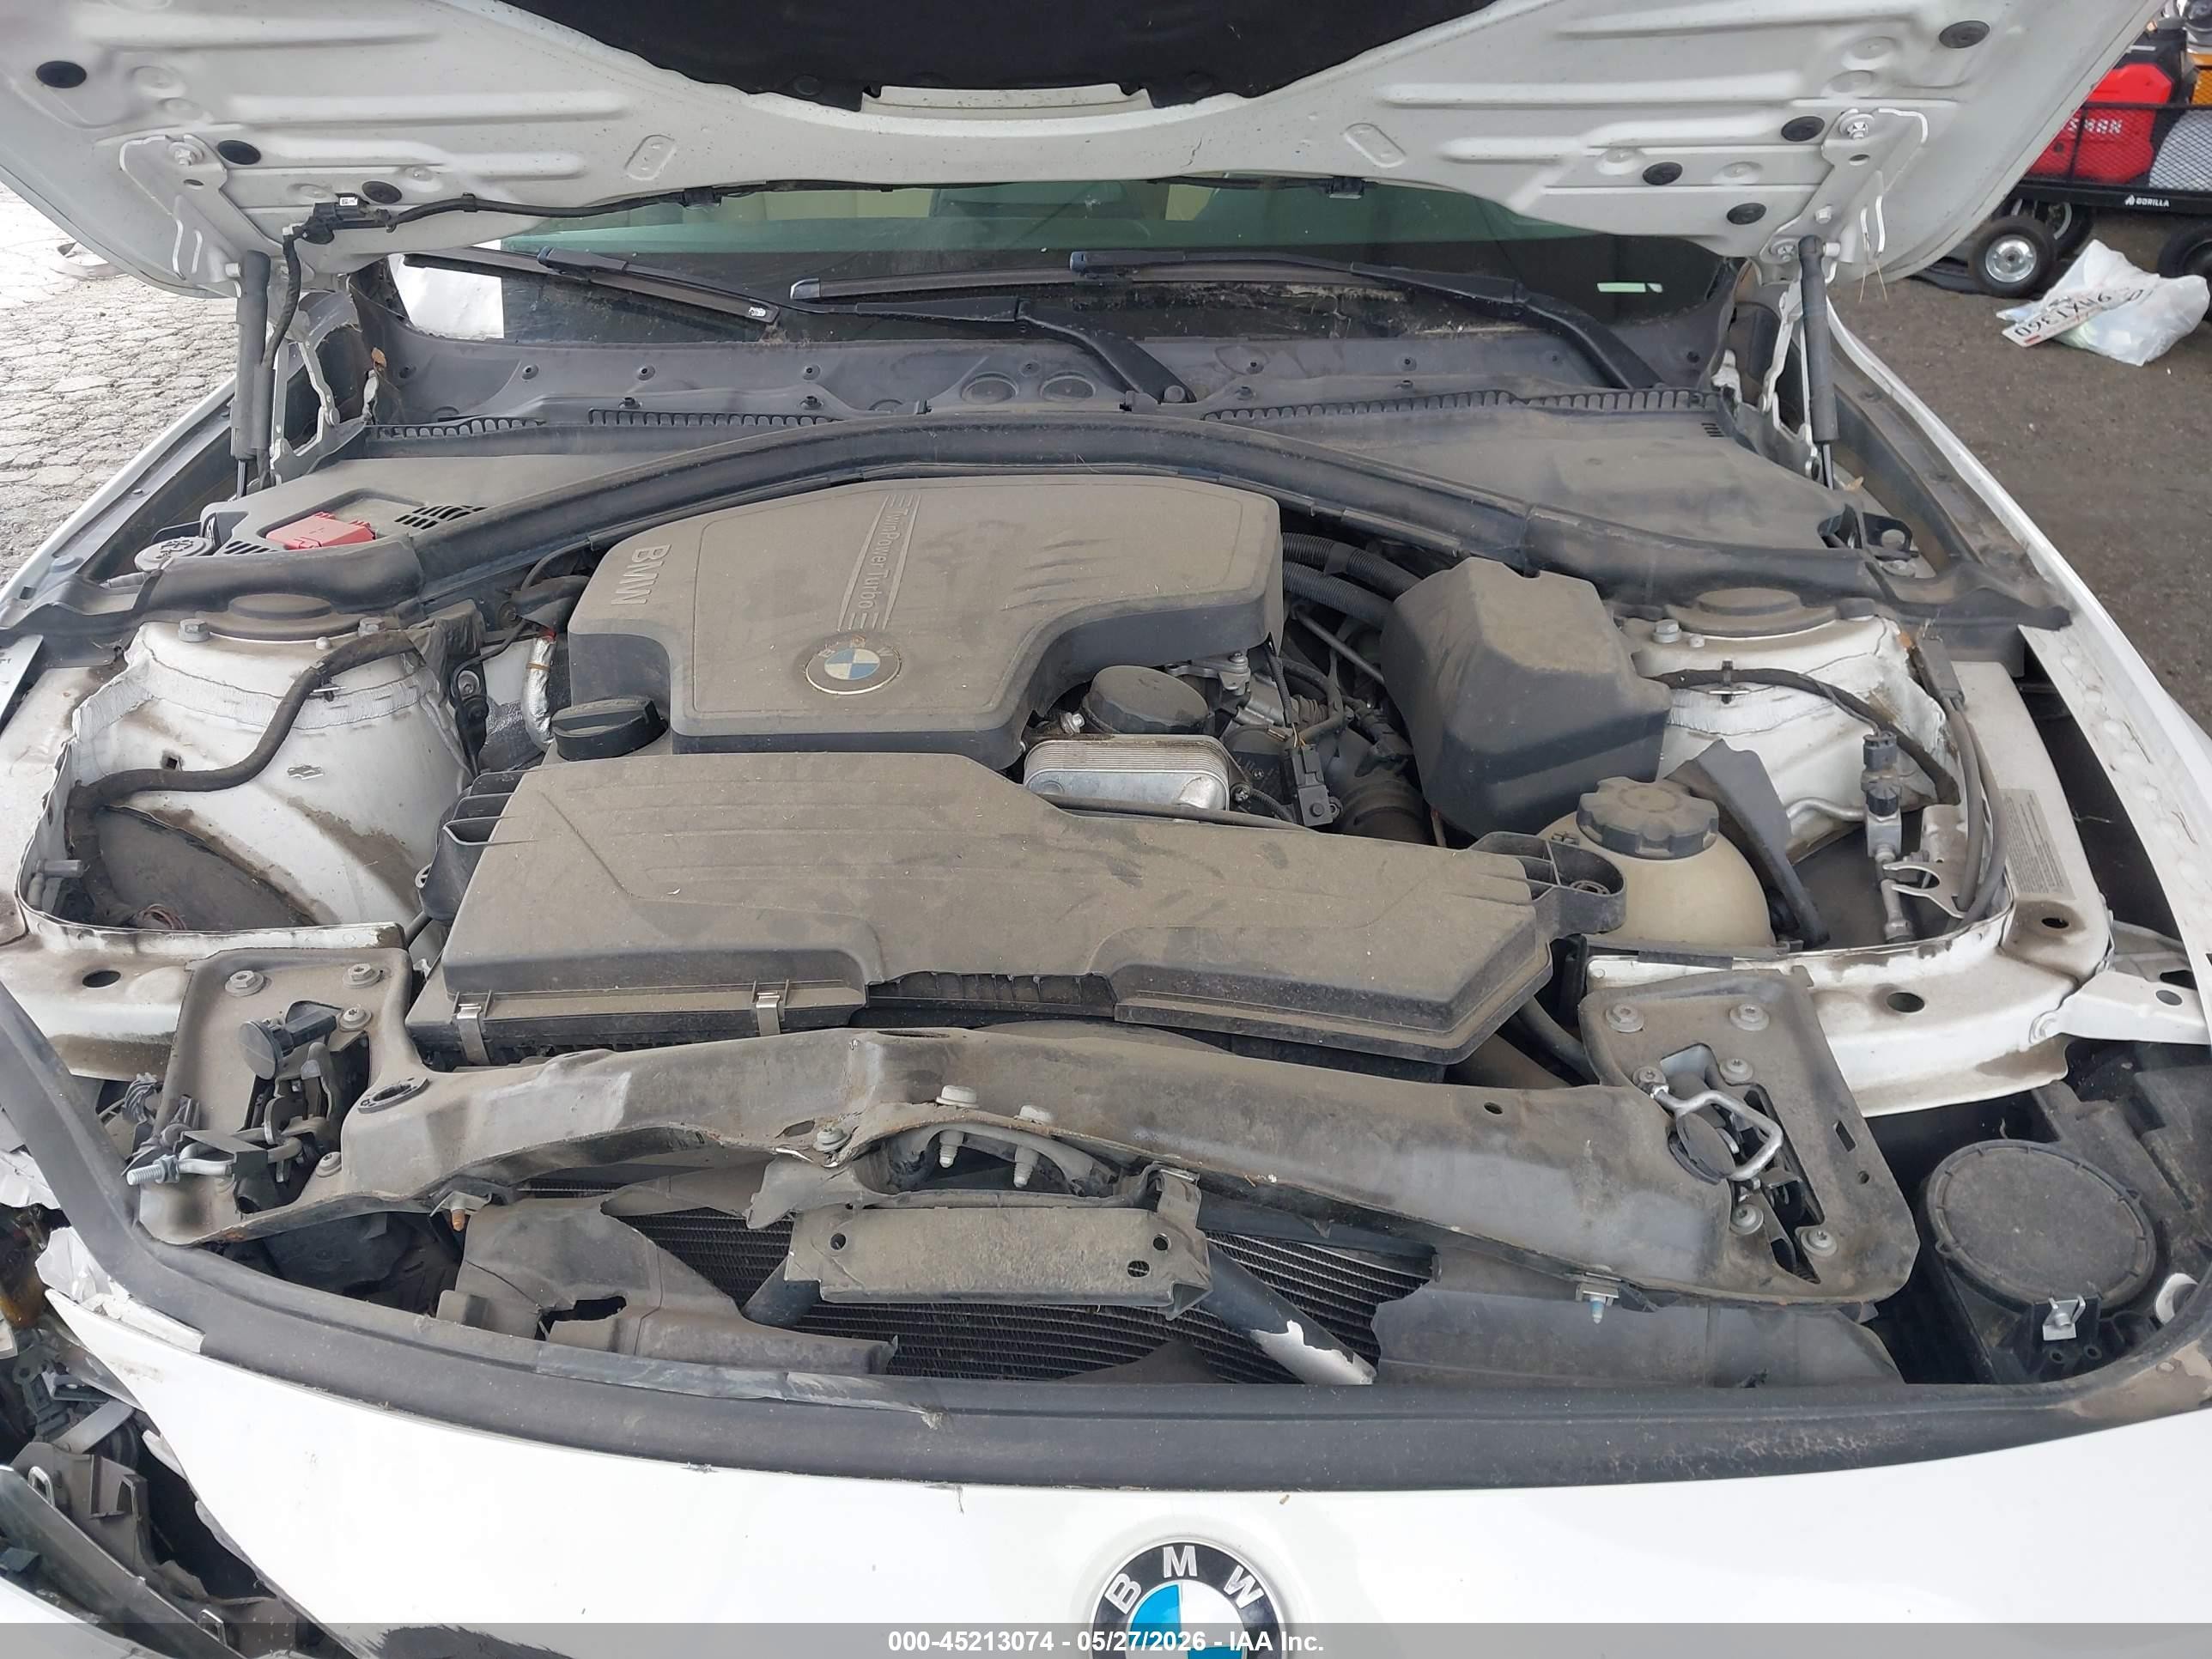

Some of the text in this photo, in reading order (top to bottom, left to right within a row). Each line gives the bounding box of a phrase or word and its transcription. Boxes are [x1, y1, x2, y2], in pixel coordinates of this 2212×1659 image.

[2136, 197, 2170, 208] GORILLA
[611, 543, 672, 605] BMW
[858, 507, 908, 609] TwinPower Turbo
[1104, 1545, 1265, 1615] BMW
